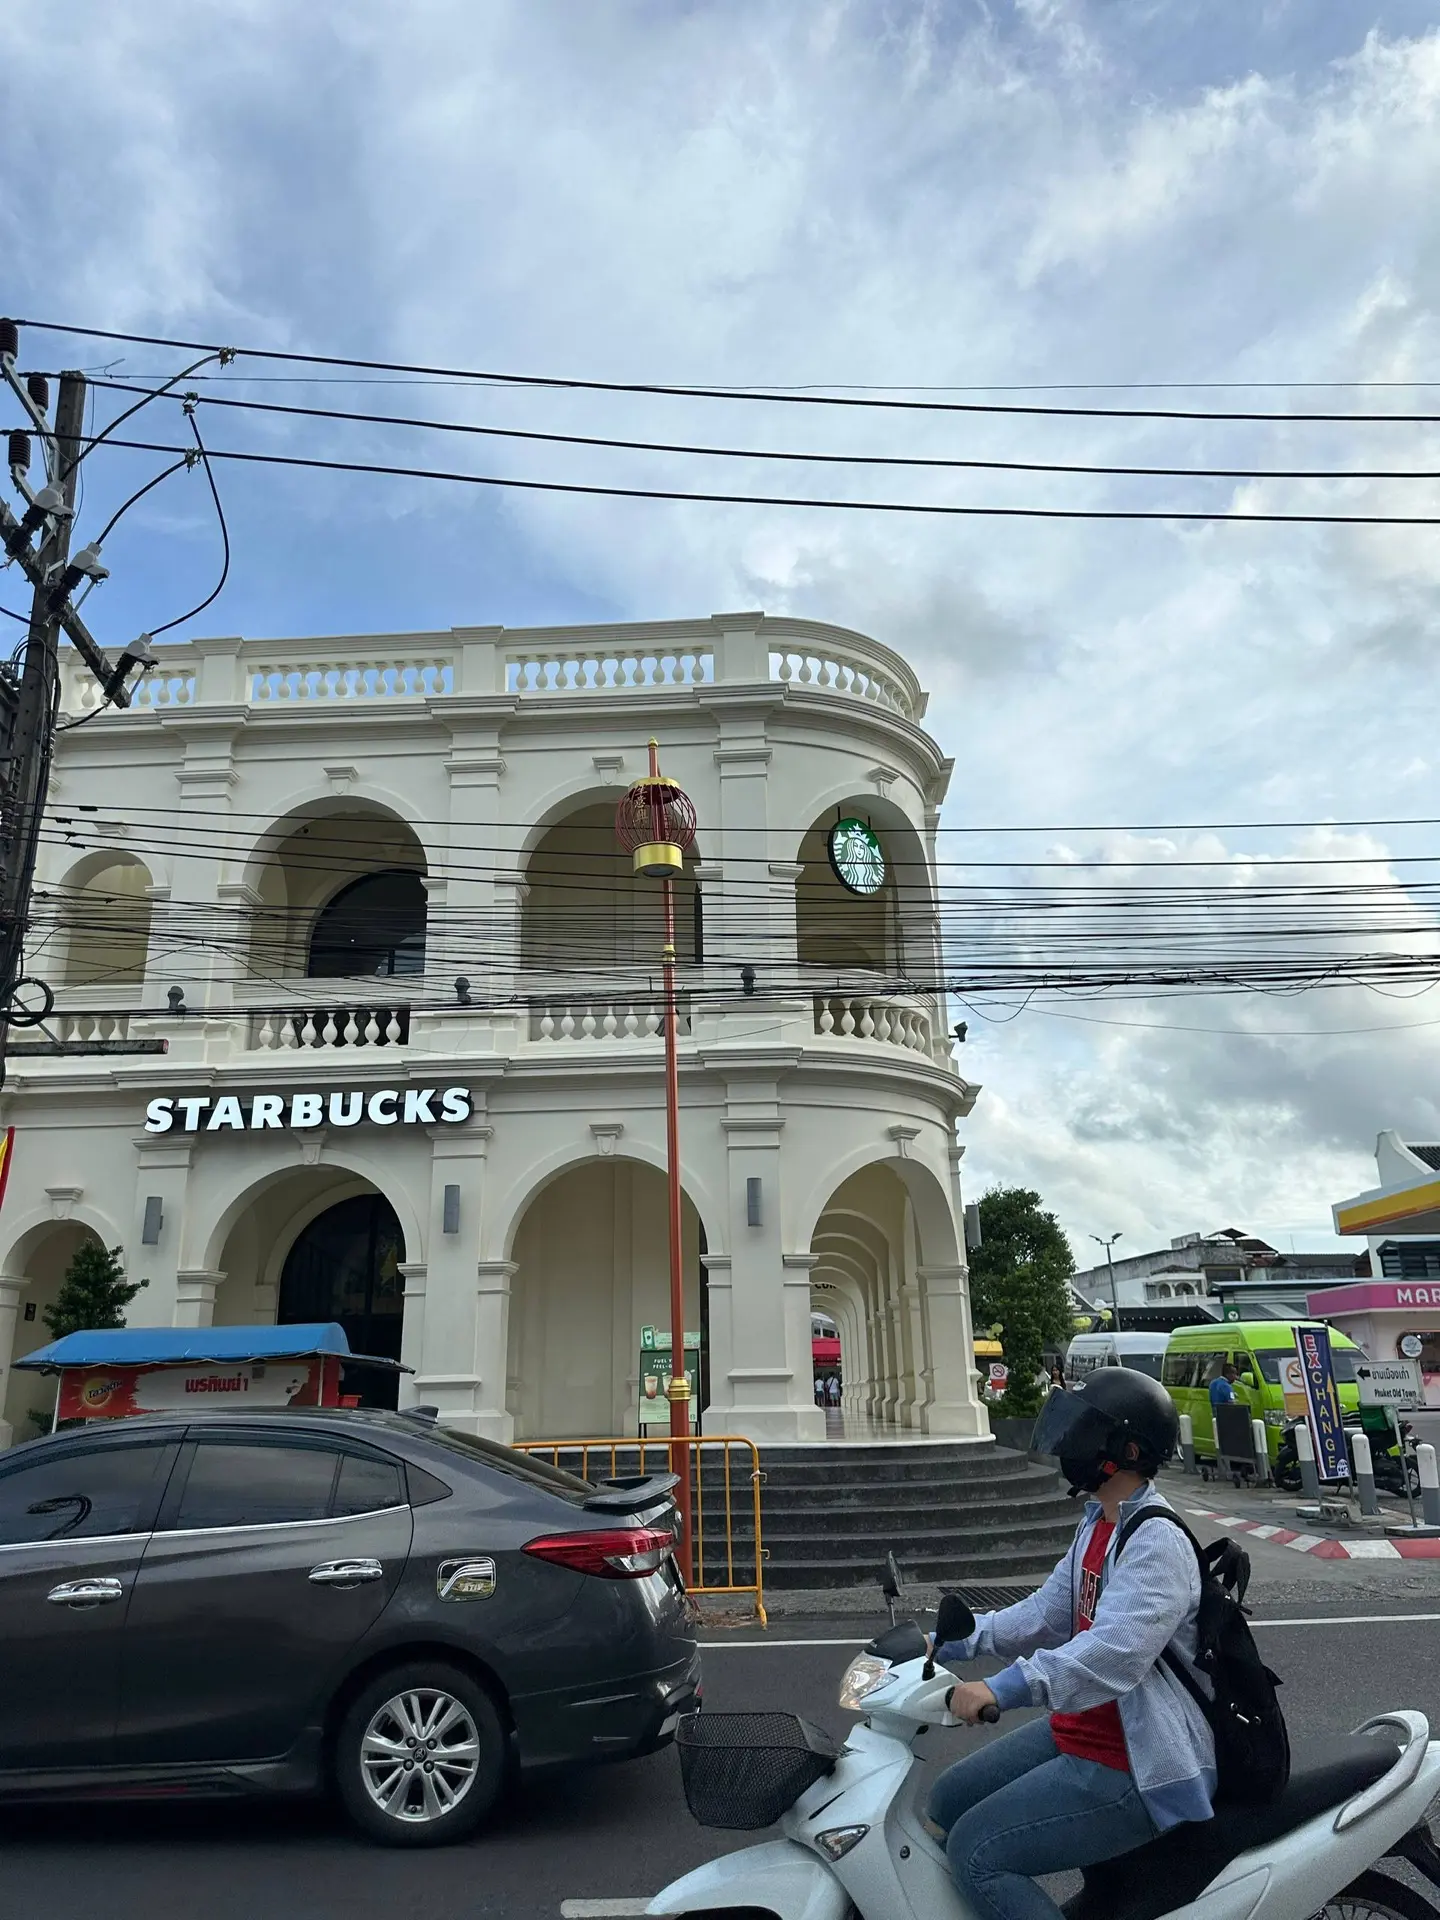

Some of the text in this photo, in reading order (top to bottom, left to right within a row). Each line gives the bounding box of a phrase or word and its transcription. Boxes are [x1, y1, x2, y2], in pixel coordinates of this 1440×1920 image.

[143, 1087, 474, 1133] STARBUCKS
[1396, 1287, 1440, 1304] MAR
[1303, 1334, 1336, 1469] EXCHANGE
[1374, 1388, 1417, 1398] Phuket Old Town
